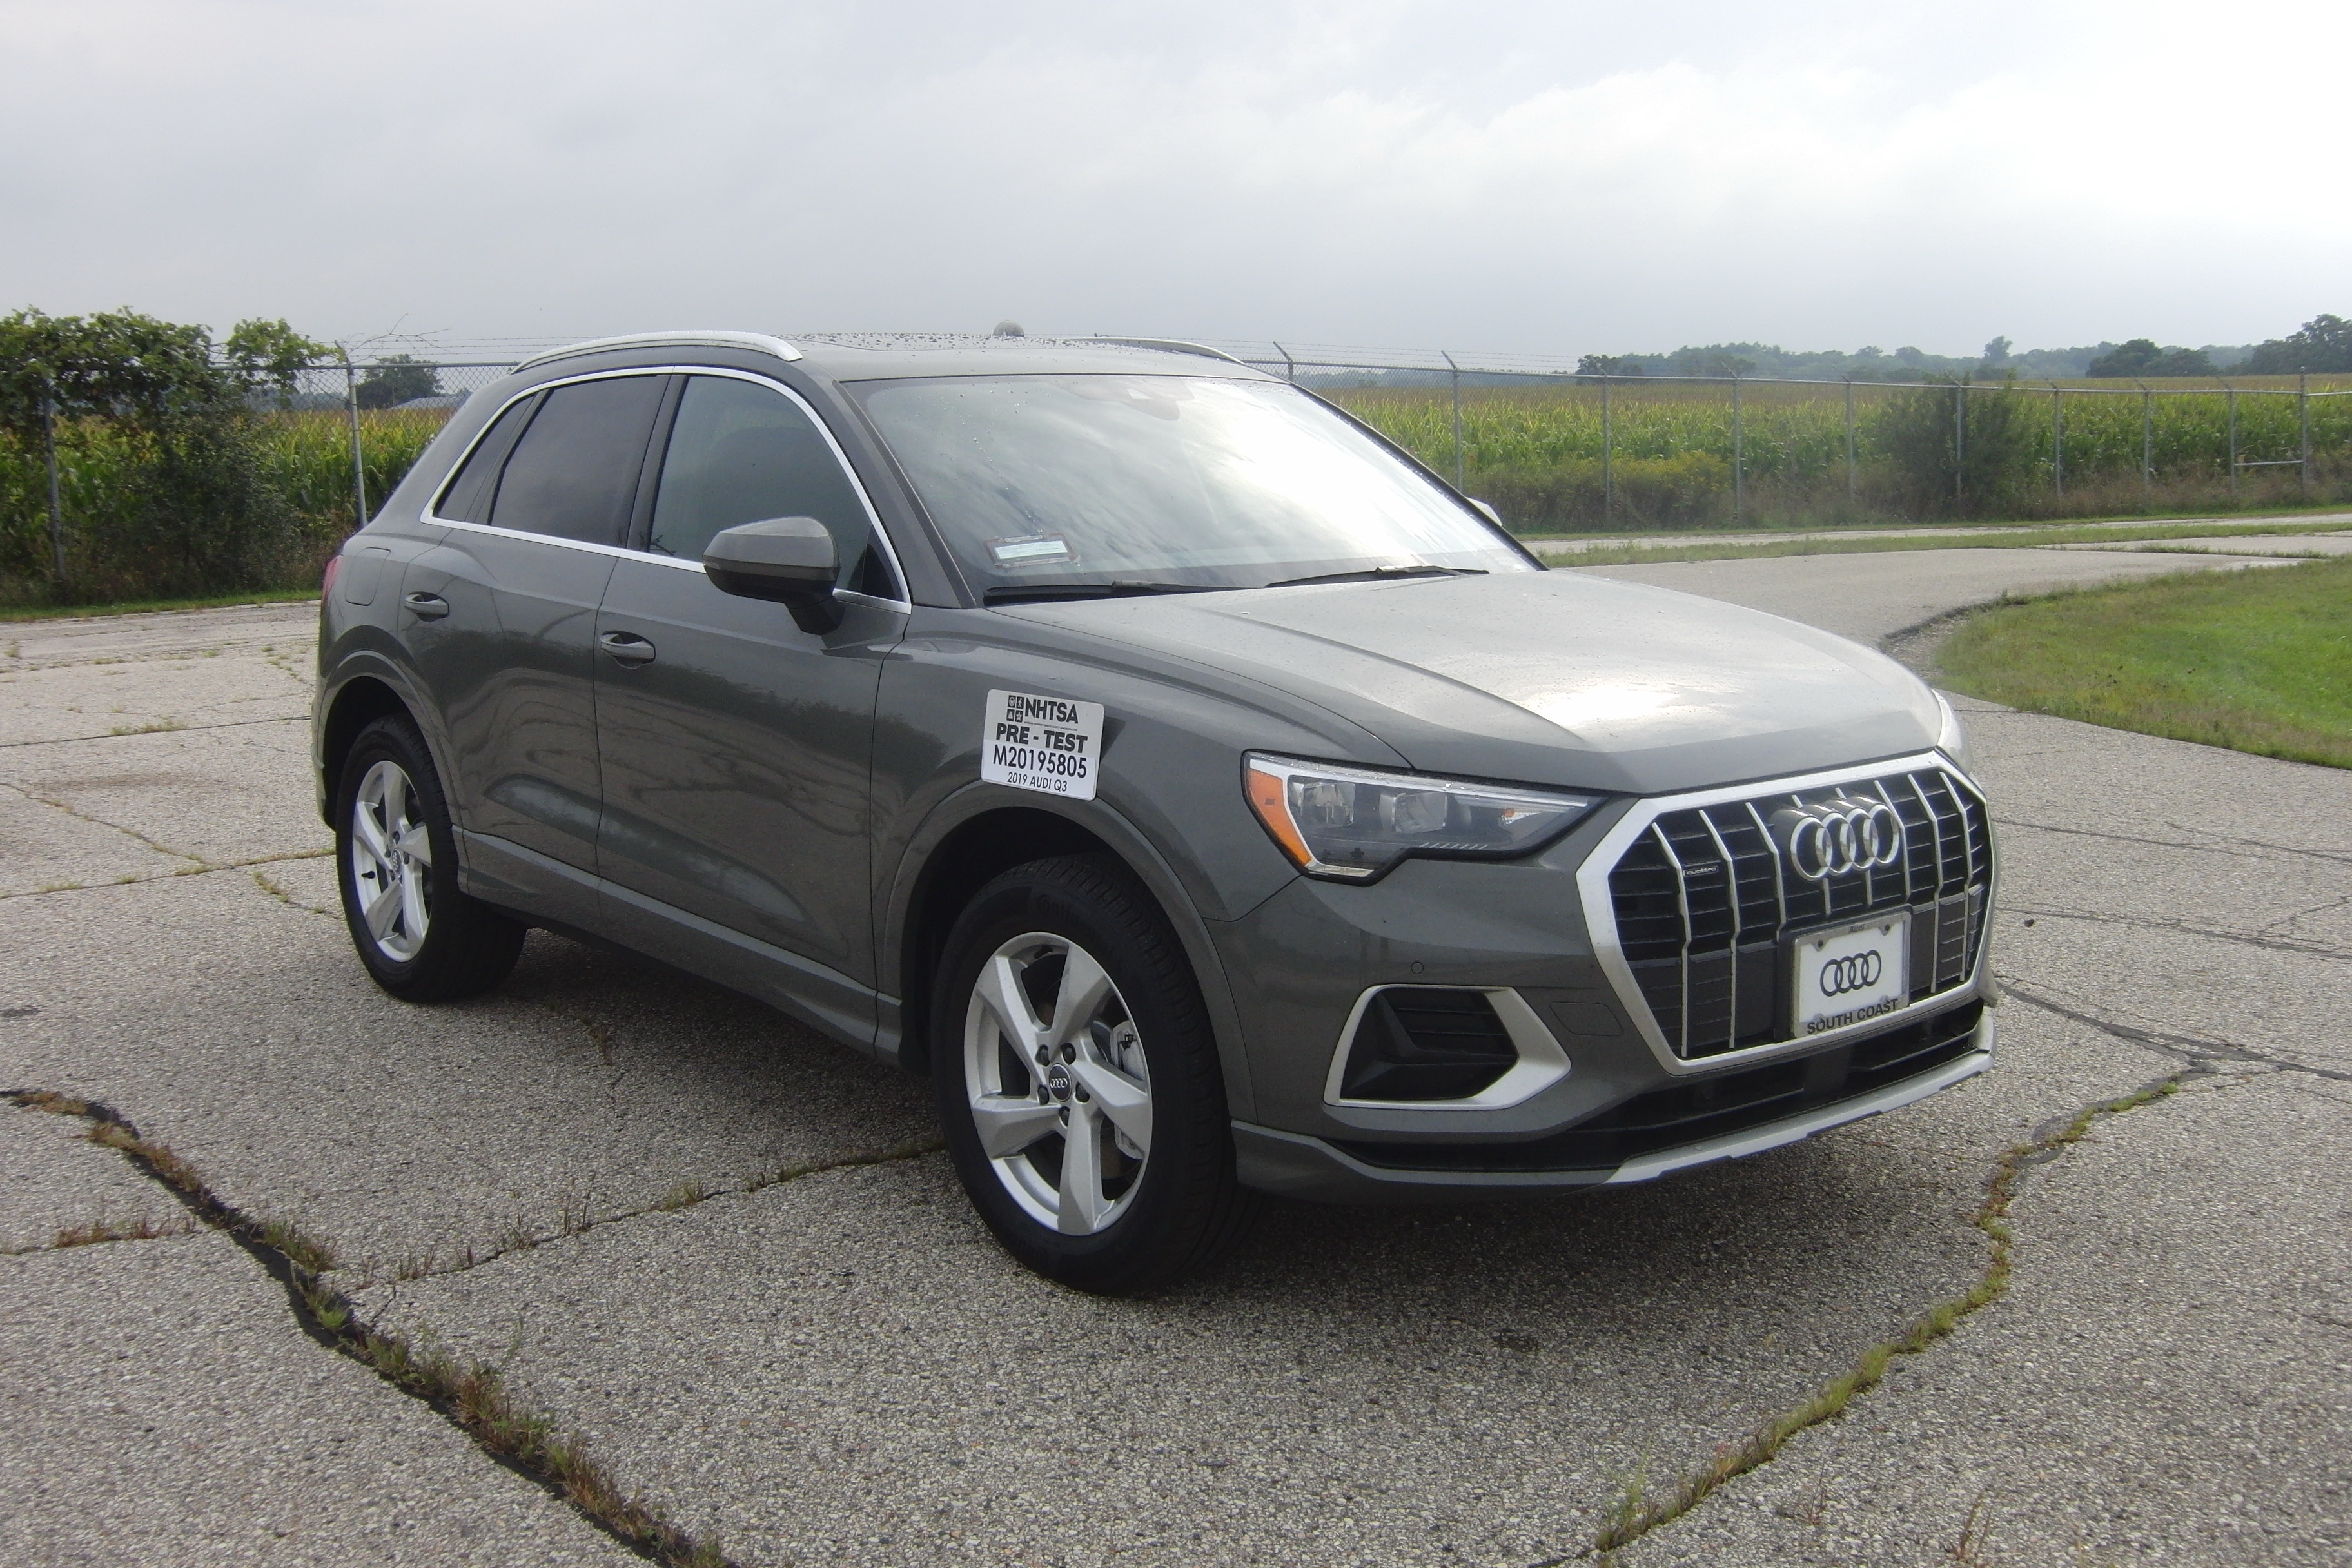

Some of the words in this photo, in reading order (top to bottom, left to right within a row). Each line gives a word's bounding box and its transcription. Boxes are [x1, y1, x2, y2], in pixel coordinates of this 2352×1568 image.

[1024, 697, 1079, 724] NHTSA
[995, 722, 1030, 745] PRE
[1043, 729, 1088, 754] TEST
[993, 744, 1087, 779] M20195805
[1007, 772, 1028, 785] 2019
[1029, 776, 1052, 790] AUDI
[1054, 779, 1068, 792] Q3
[1807, 1012, 1853, 1035] SOUTH
[1857, 998, 1898, 1021] COAST
